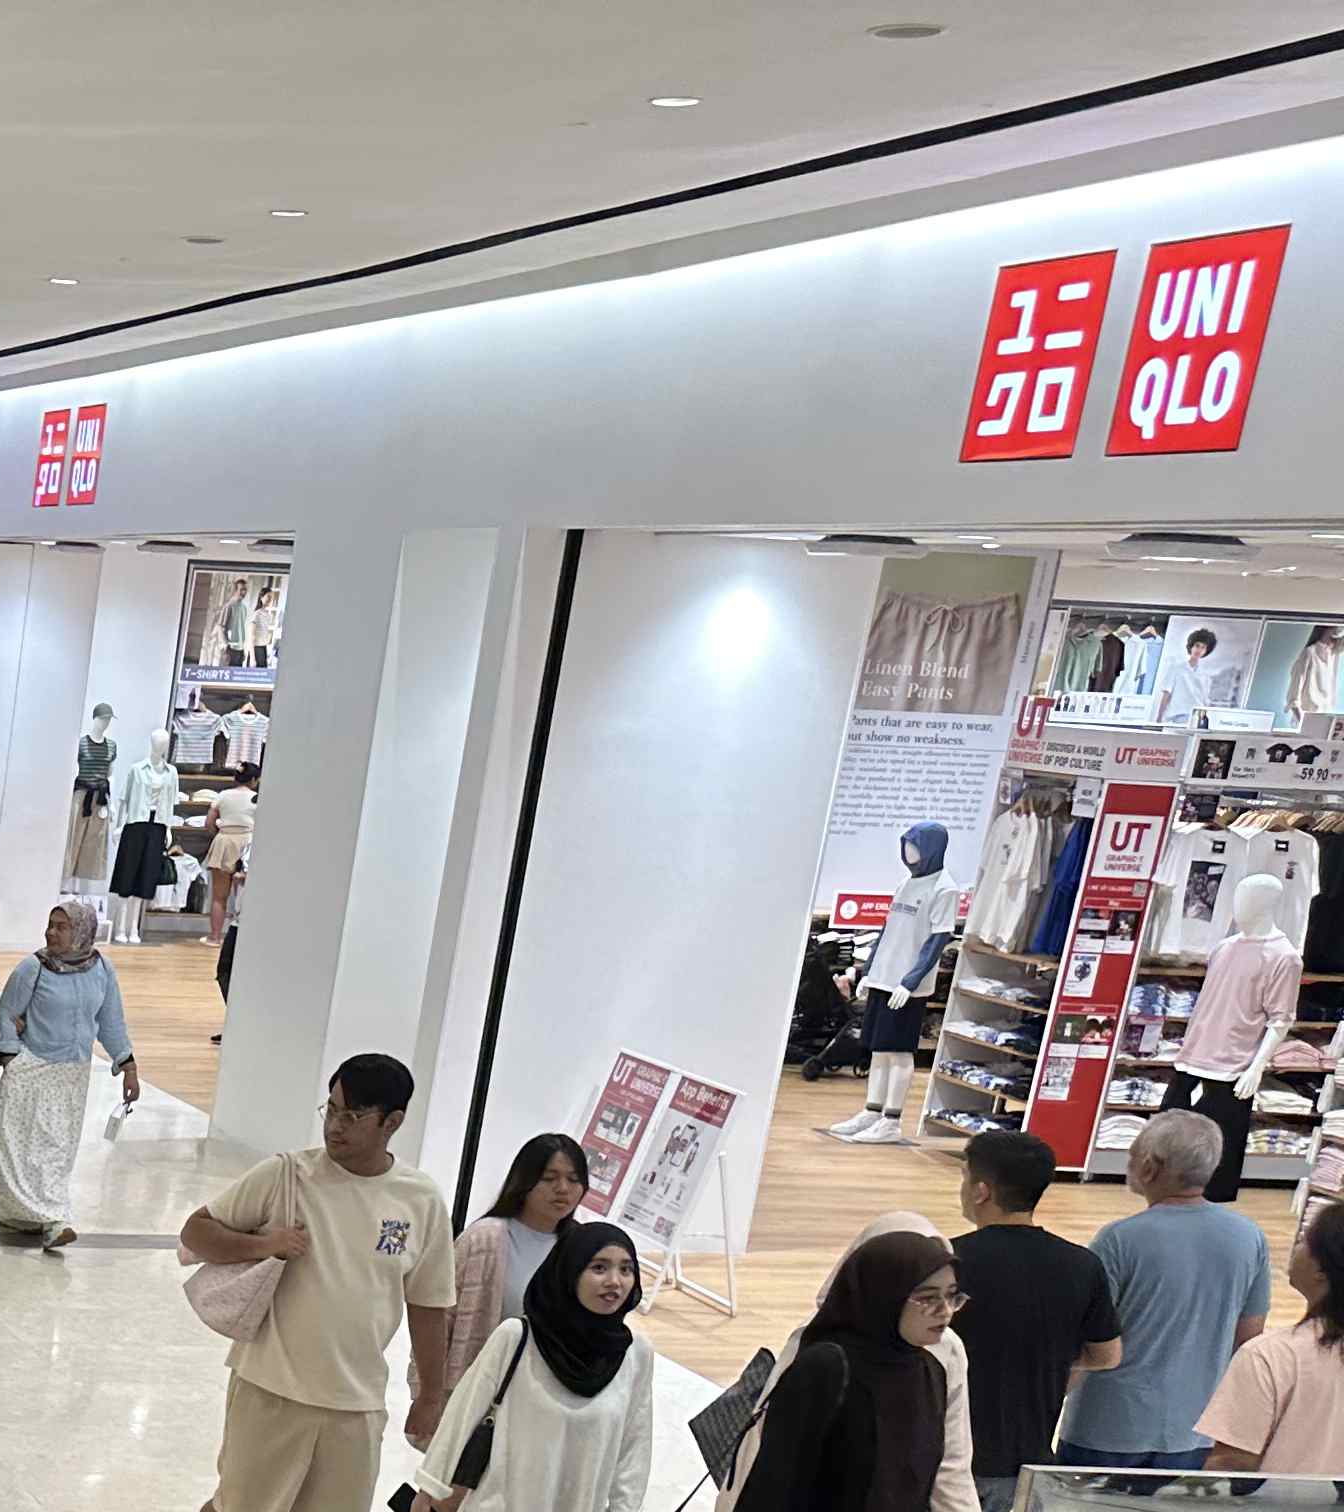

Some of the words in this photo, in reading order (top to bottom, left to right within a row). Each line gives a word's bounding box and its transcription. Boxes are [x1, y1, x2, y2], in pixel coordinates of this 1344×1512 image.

[1149, 259, 1257, 341] UNI
[996, 281, 1090, 355] ユニ
[976, 366, 1075, 437] クロ
[1129, 350, 1241, 440] QLO
[76, 418, 100, 453] UNI
[72, 458, 97, 498] QLO
[185, 668, 231, 680] T-SHIRTS
[863, 659, 913, 677] Linen
[919, 660, 969, 680] Blend
[861, 680, 898, 700] Easy
[907, 682, 954, 700] Pants
[880, 715, 902, 728] that
[904, 719, 923, 729] are
[925, 721, 949, 732] easy
[952, 720, 963, 731] to
[1016, 696, 1055, 738] UT
[865, 731, 893, 743] show
[896, 734, 911, 744] no
[914, 733, 966, 745] weakness.
[1082, 745, 1106, 757] WORLD
[1115, 747, 1137, 765] UT
[1043, 753, 1053, 766] OF
[1054, 755, 1068, 768] POP
[1069, 756, 1104, 772] CULTURE
[1300, 767, 1329, 781] 59.90
[1110, 821, 1152, 852] UT
[1104, 863, 1143, 873] UNIVERSE
[612, 1057, 636, 1086] UT
[680, 1081, 697, 1102] App
